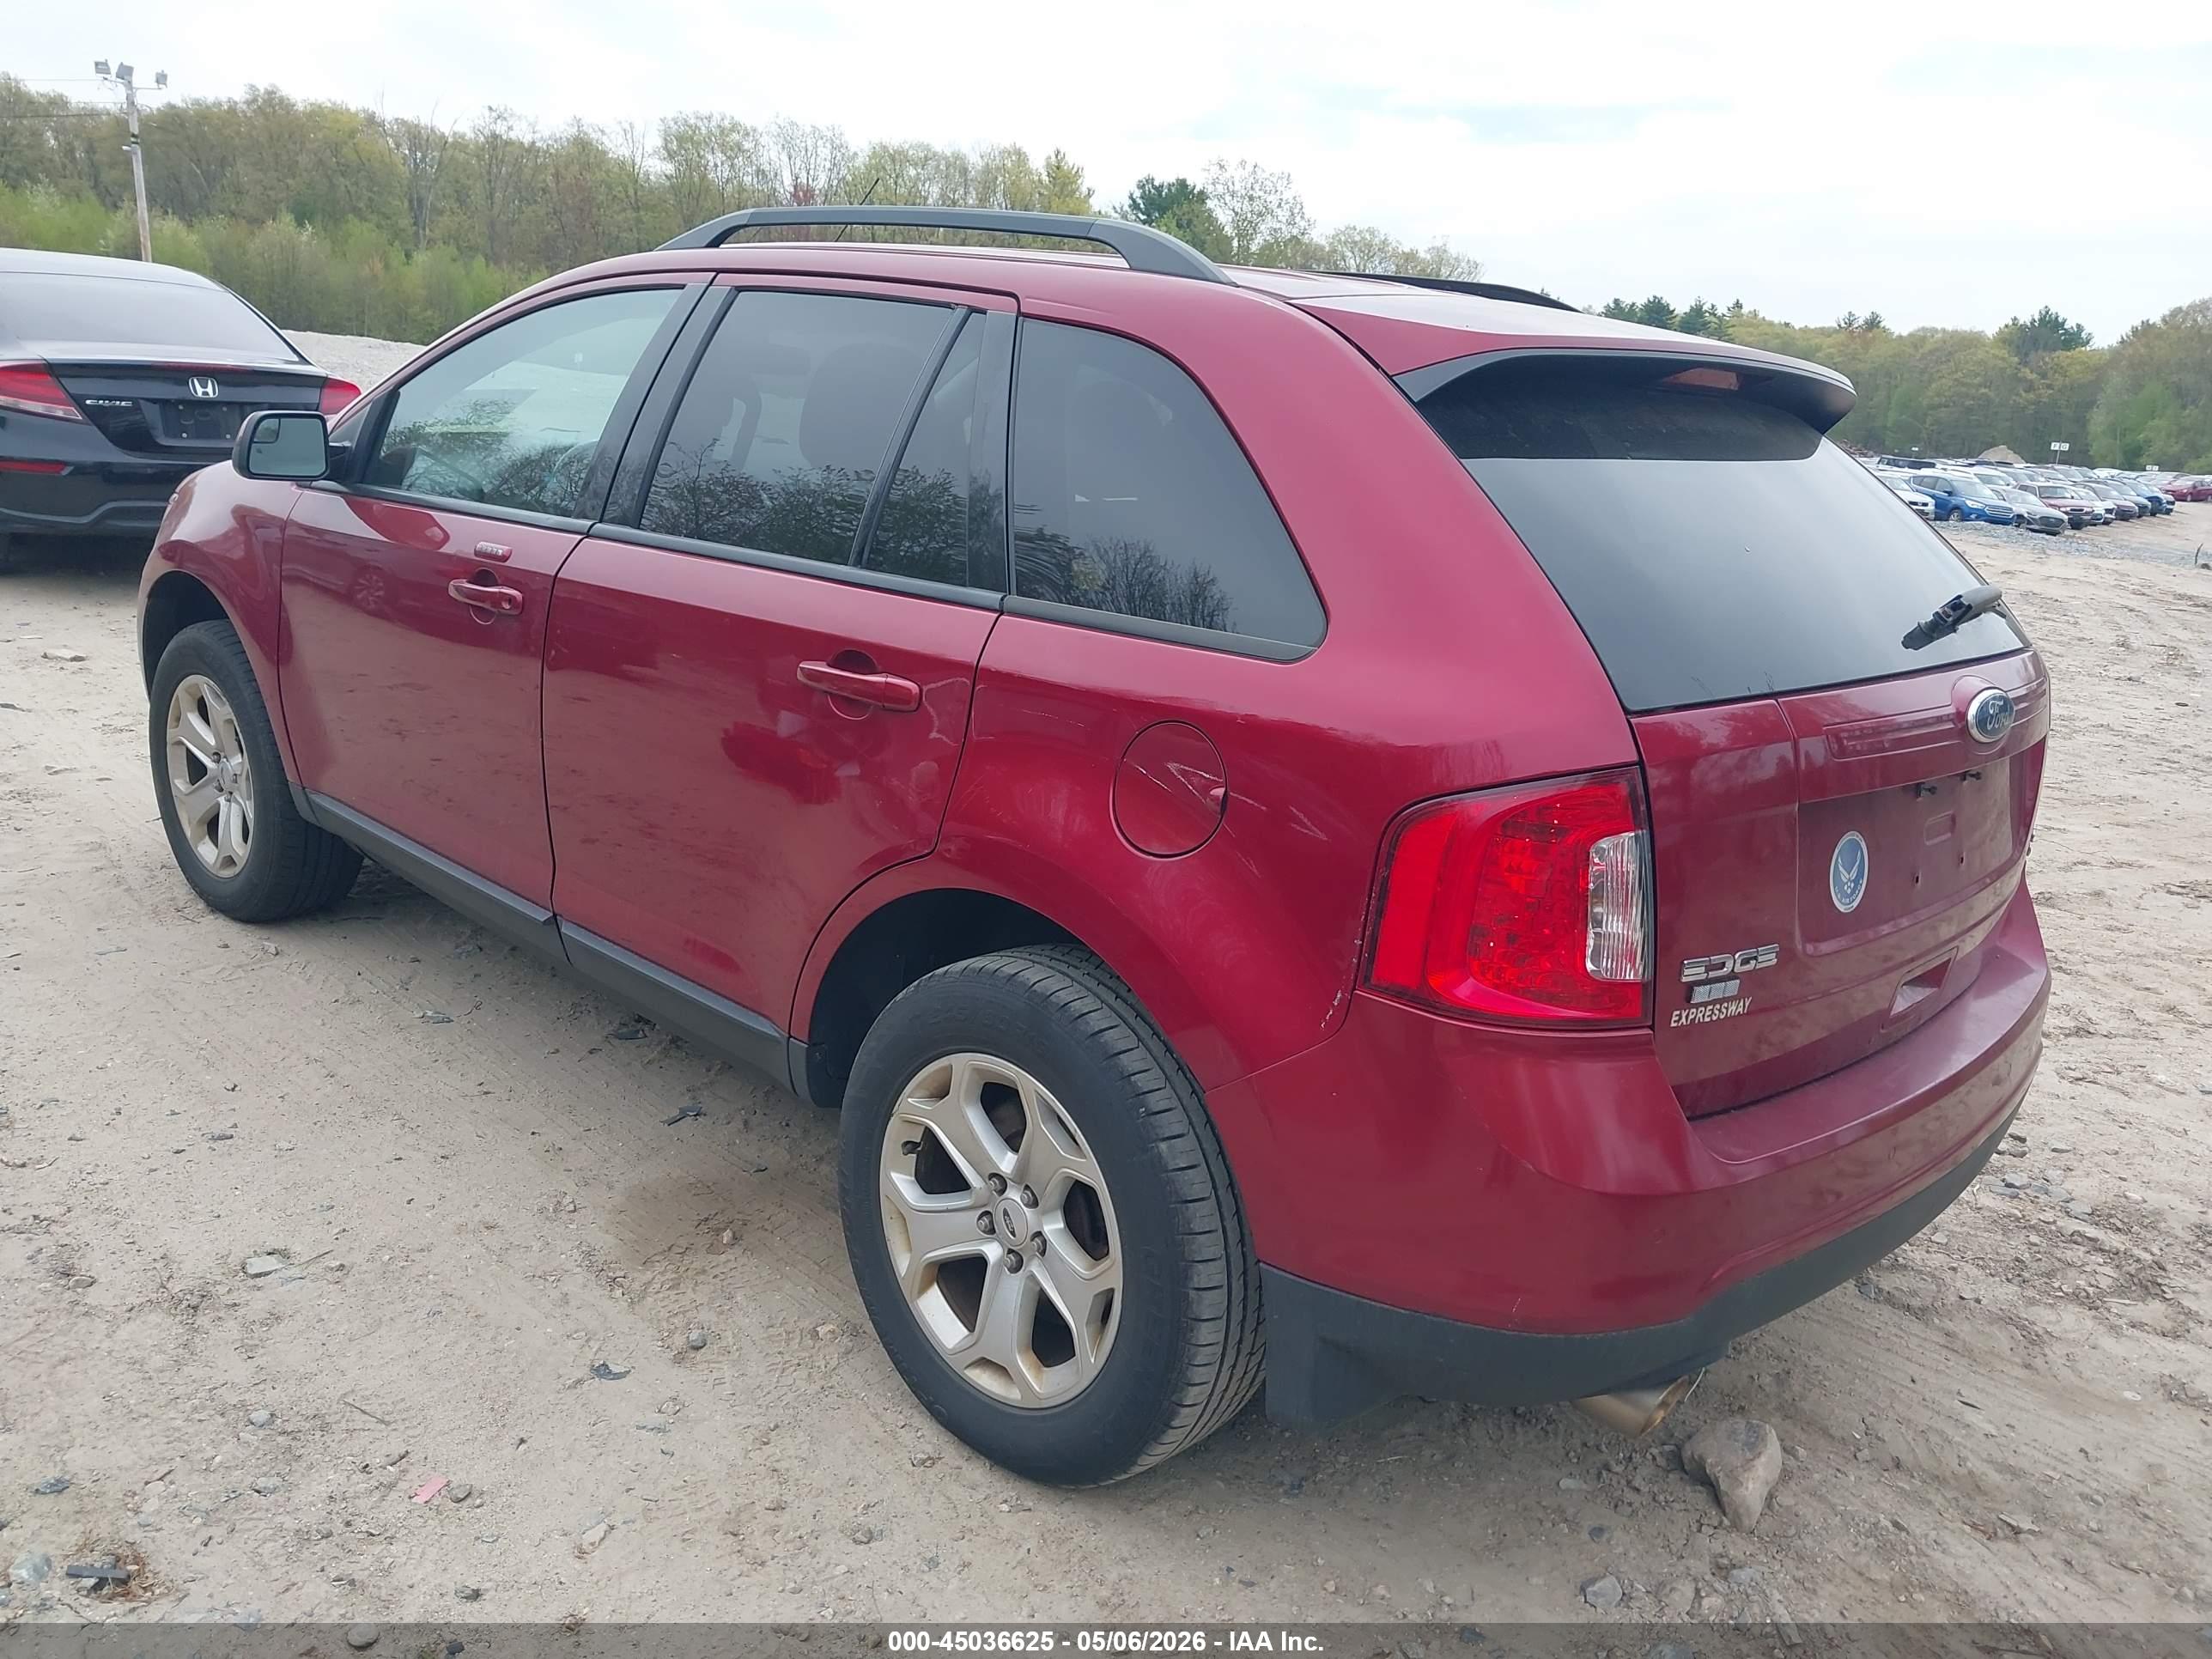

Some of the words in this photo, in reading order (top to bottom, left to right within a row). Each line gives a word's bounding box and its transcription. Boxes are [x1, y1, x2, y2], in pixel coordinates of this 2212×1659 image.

[85, 398, 133, 407] CIVIC
[1987, 698, 2011, 731] Ford
[1680, 944, 1780, 983] EDGE
[1670, 996, 1753, 1028] EXPRESSWAY
